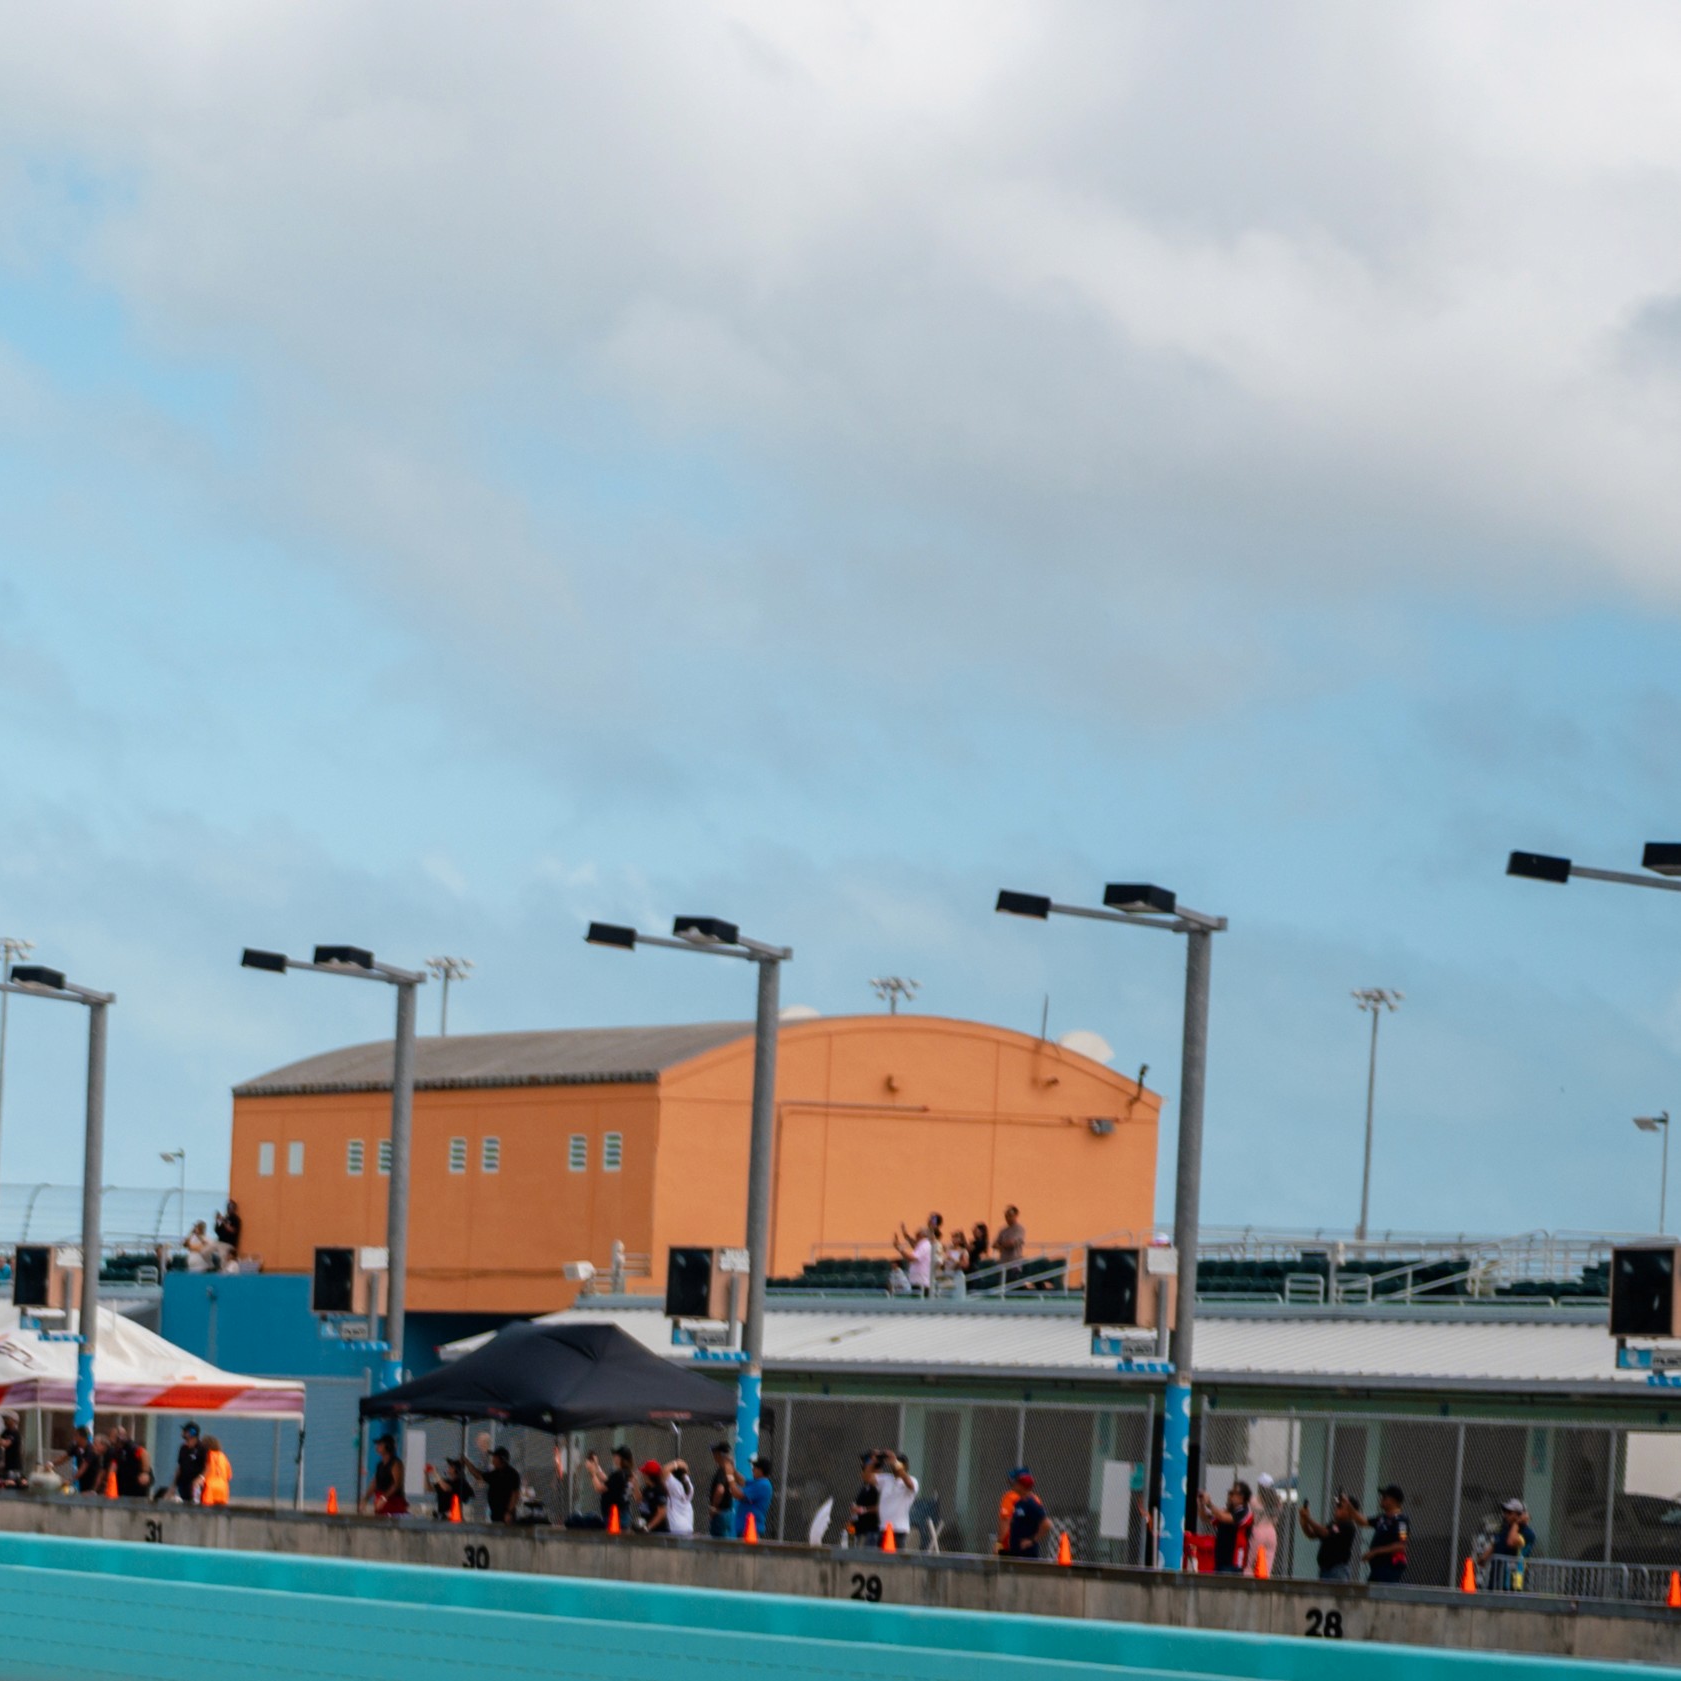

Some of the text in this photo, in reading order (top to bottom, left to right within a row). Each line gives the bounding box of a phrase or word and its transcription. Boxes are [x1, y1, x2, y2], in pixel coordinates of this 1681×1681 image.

[145, 1519, 164, 1544] 31
[462, 1545, 490, 1570] 30
[851, 1573, 883, 1602] 29
[1305, 1606, 1343, 1638] 28
